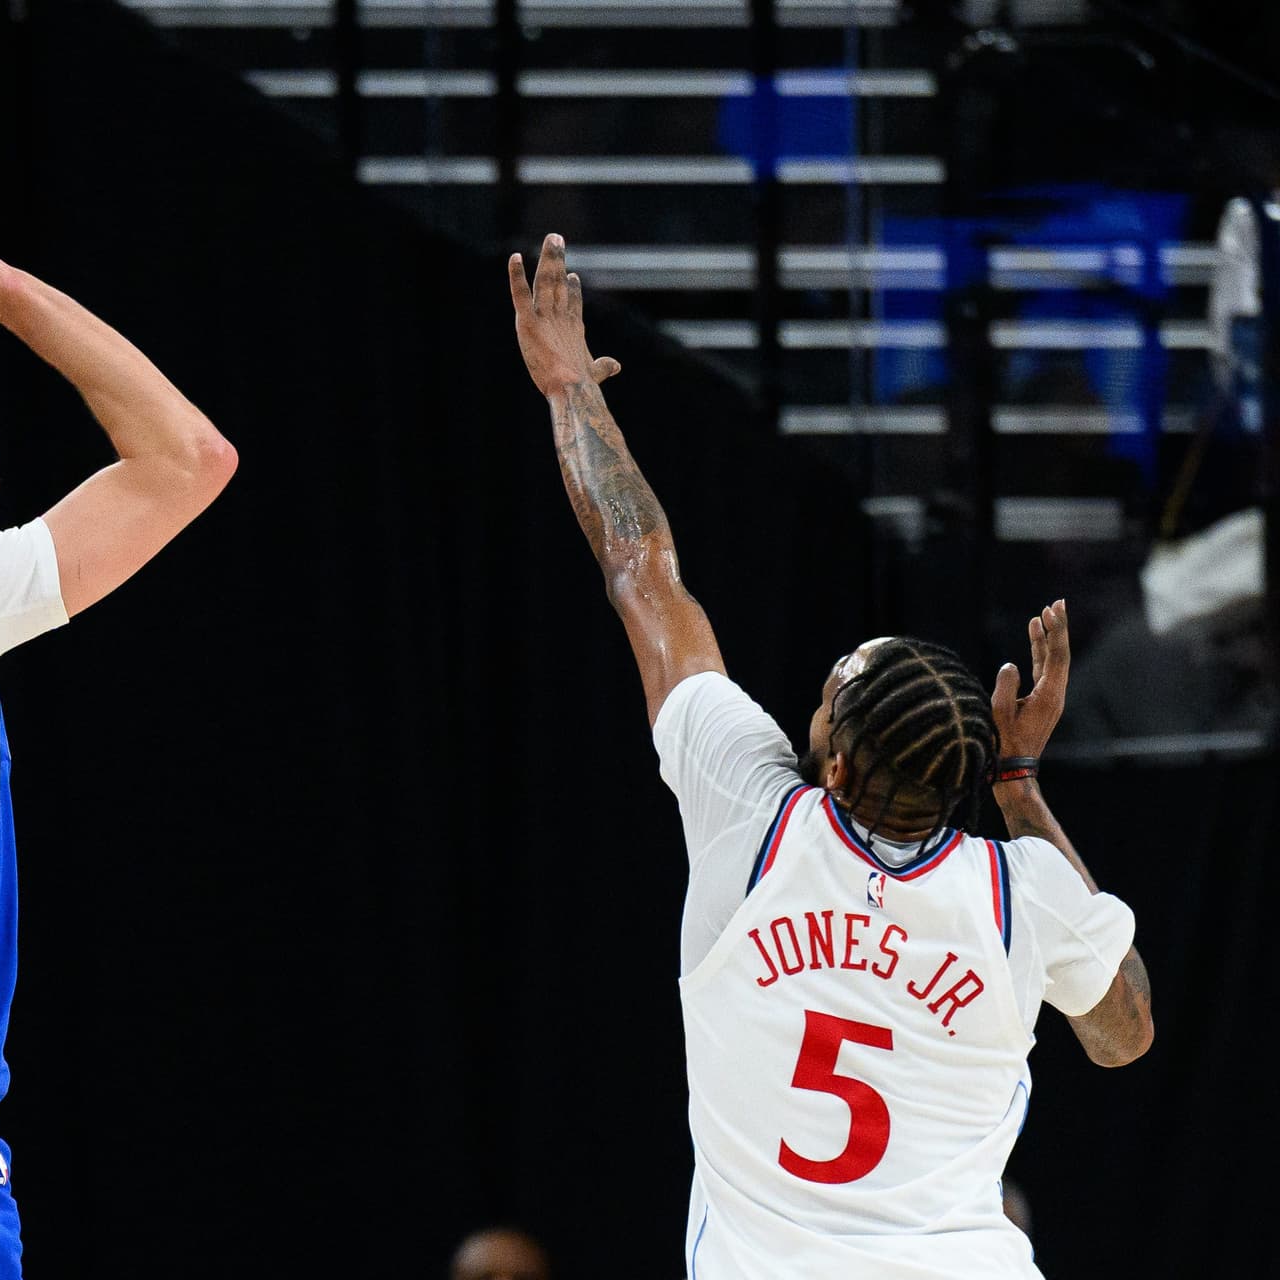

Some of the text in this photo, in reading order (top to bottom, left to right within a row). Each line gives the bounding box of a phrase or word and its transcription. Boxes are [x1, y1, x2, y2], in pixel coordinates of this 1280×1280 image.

[748, 910, 985, 1038] JONES JR.
[777, 1009, 894, 1185] 5
